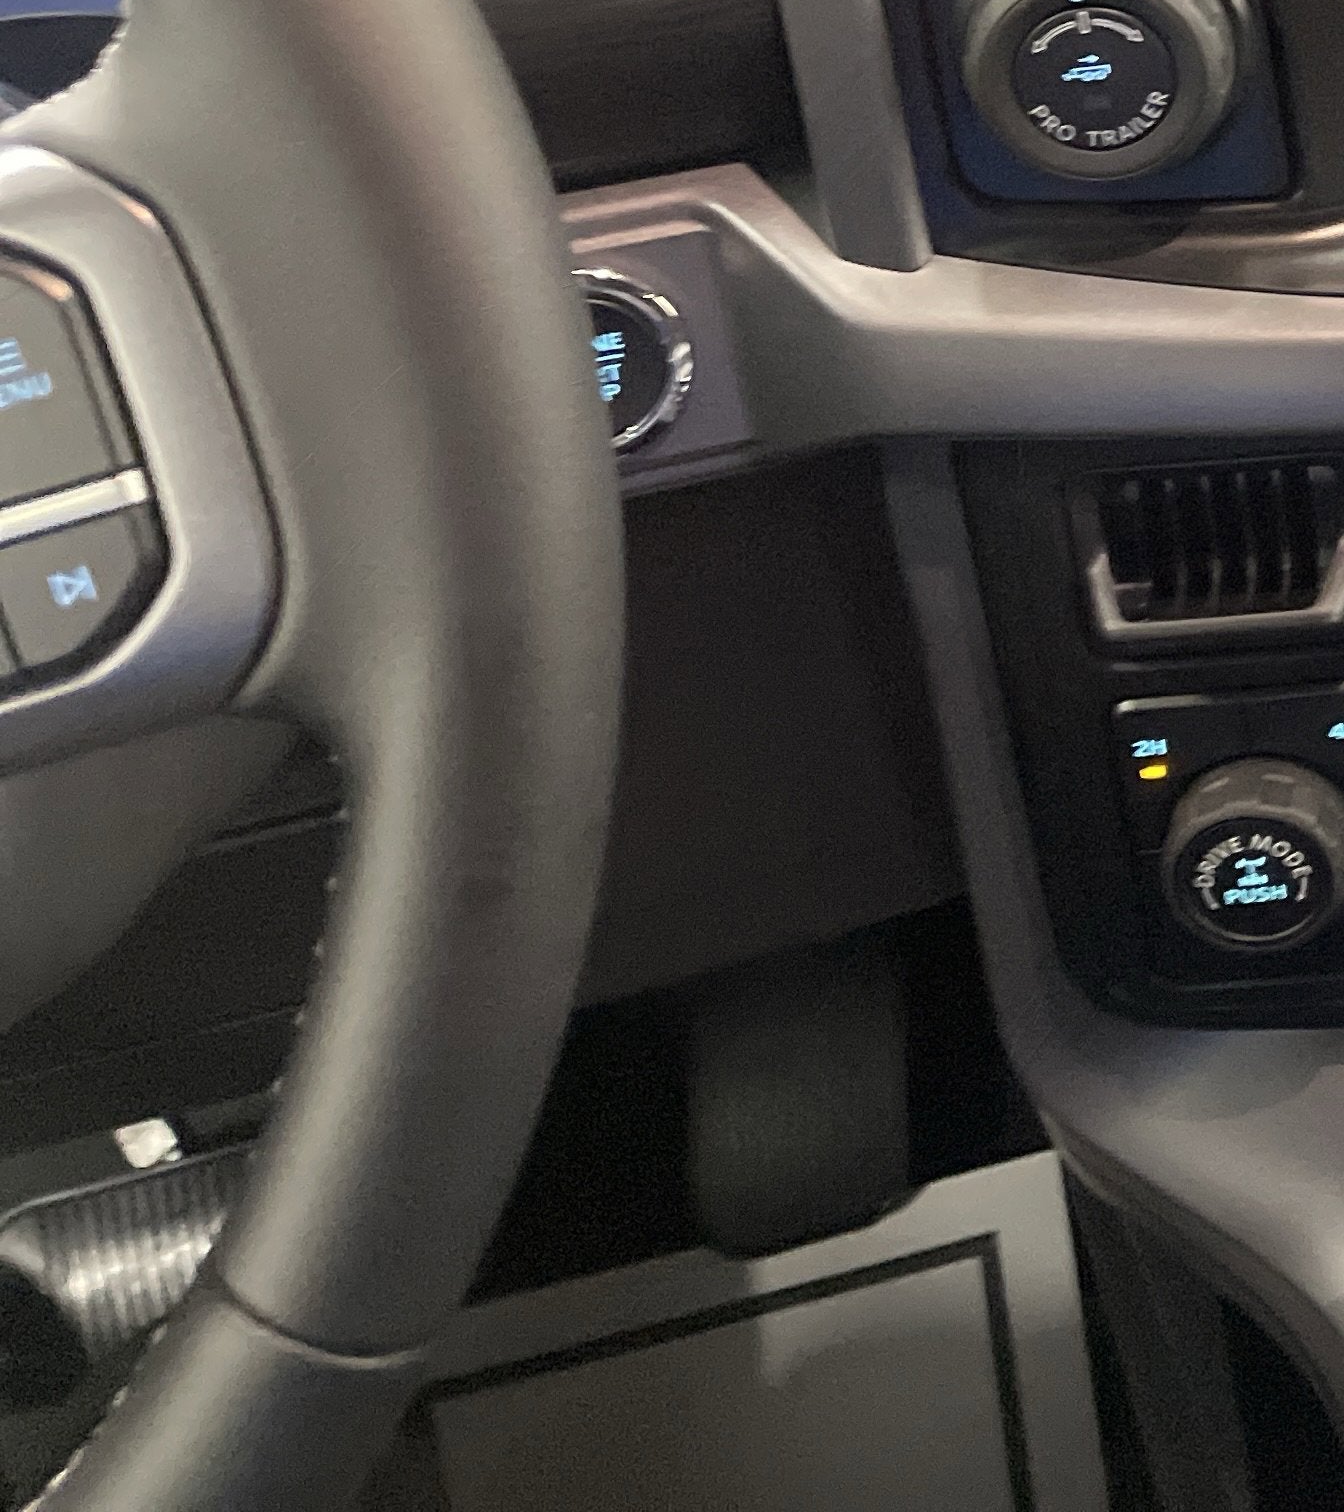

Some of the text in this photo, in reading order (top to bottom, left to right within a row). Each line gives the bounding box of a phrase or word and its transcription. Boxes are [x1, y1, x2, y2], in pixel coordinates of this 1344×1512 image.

[1027, 90, 1171, 149] PRO TRAILER
[1130, 738, 1168, 759] 2H
[1222, 883, 1288, 906] PUSH
